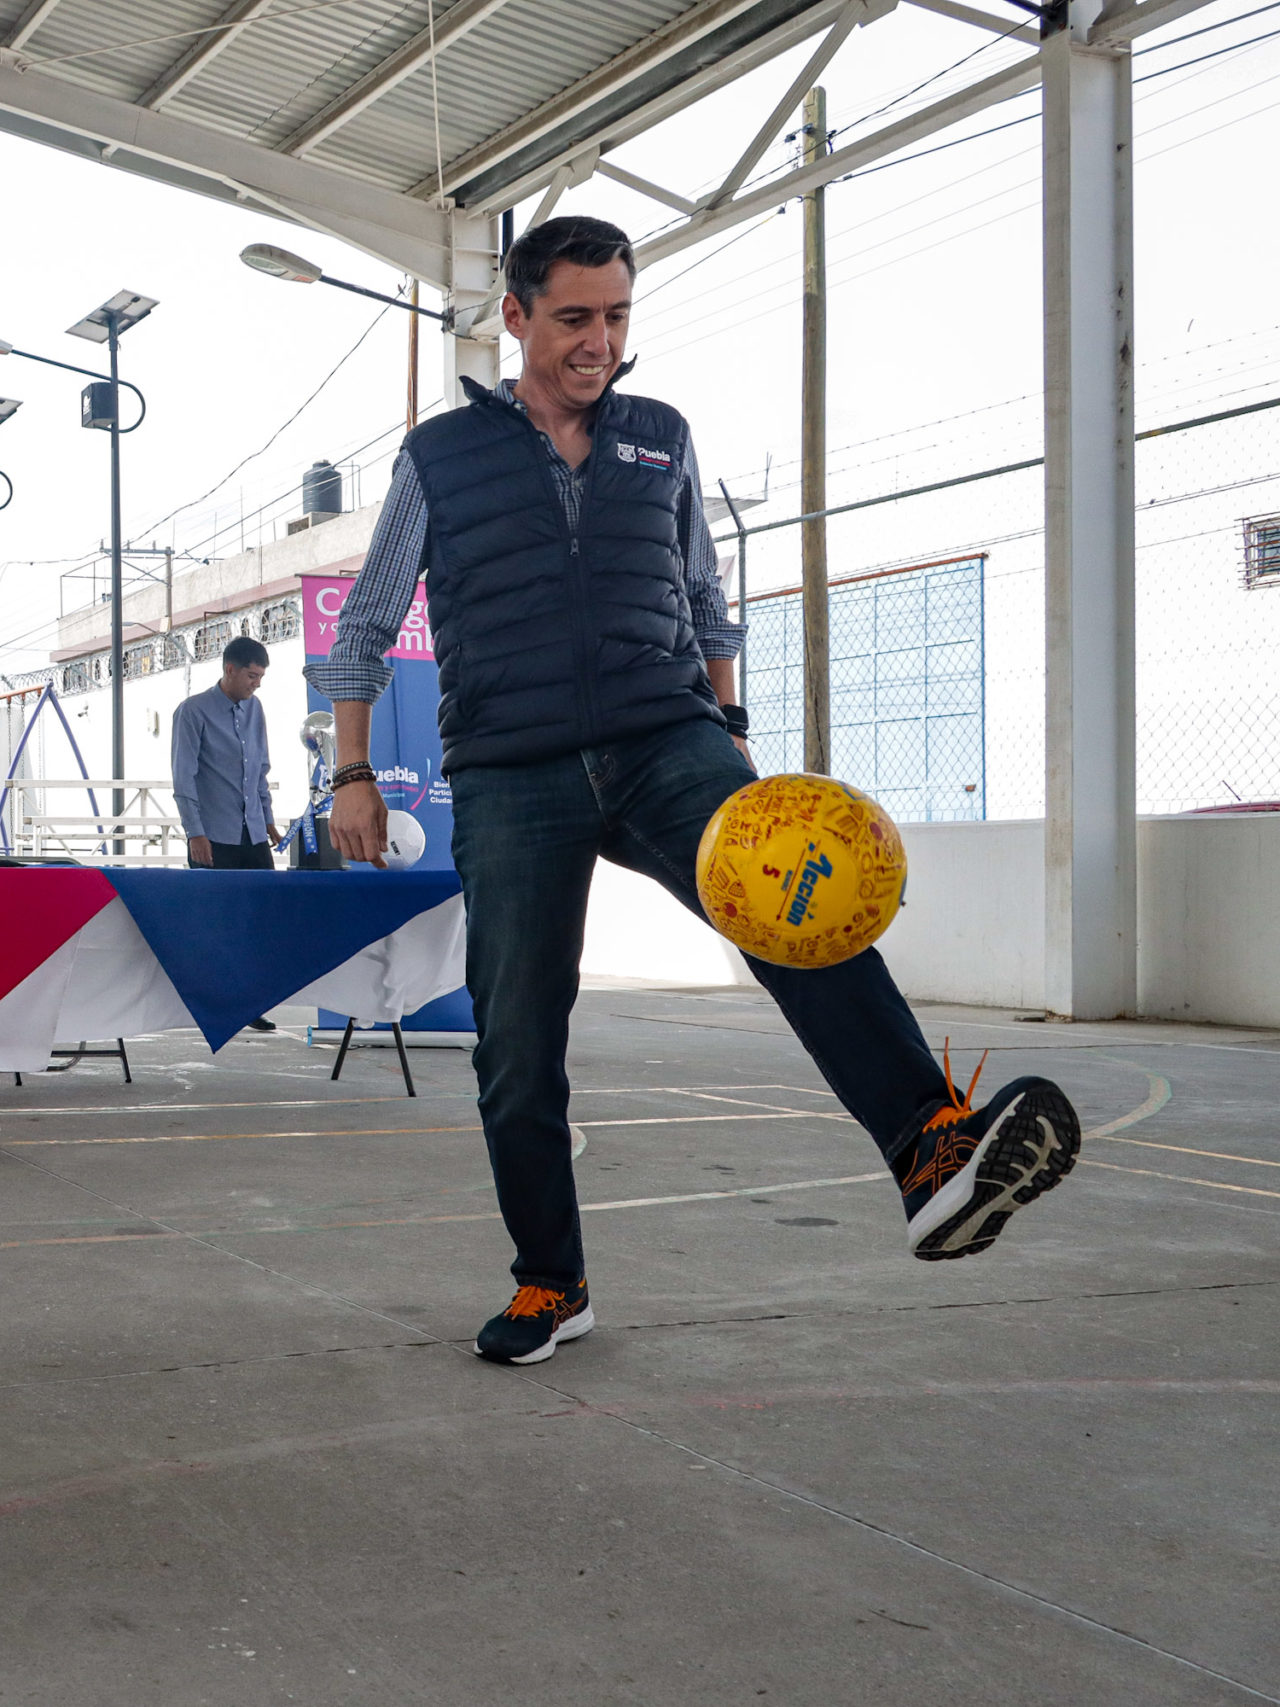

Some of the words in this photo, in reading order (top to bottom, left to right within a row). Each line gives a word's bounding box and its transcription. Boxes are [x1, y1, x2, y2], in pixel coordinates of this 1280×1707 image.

[638, 447, 671, 461] Puebla
[372, 766, 419, 784] uebla
[762, 864, 781, 879] 5
[786, 842, 833, 927] Acción
